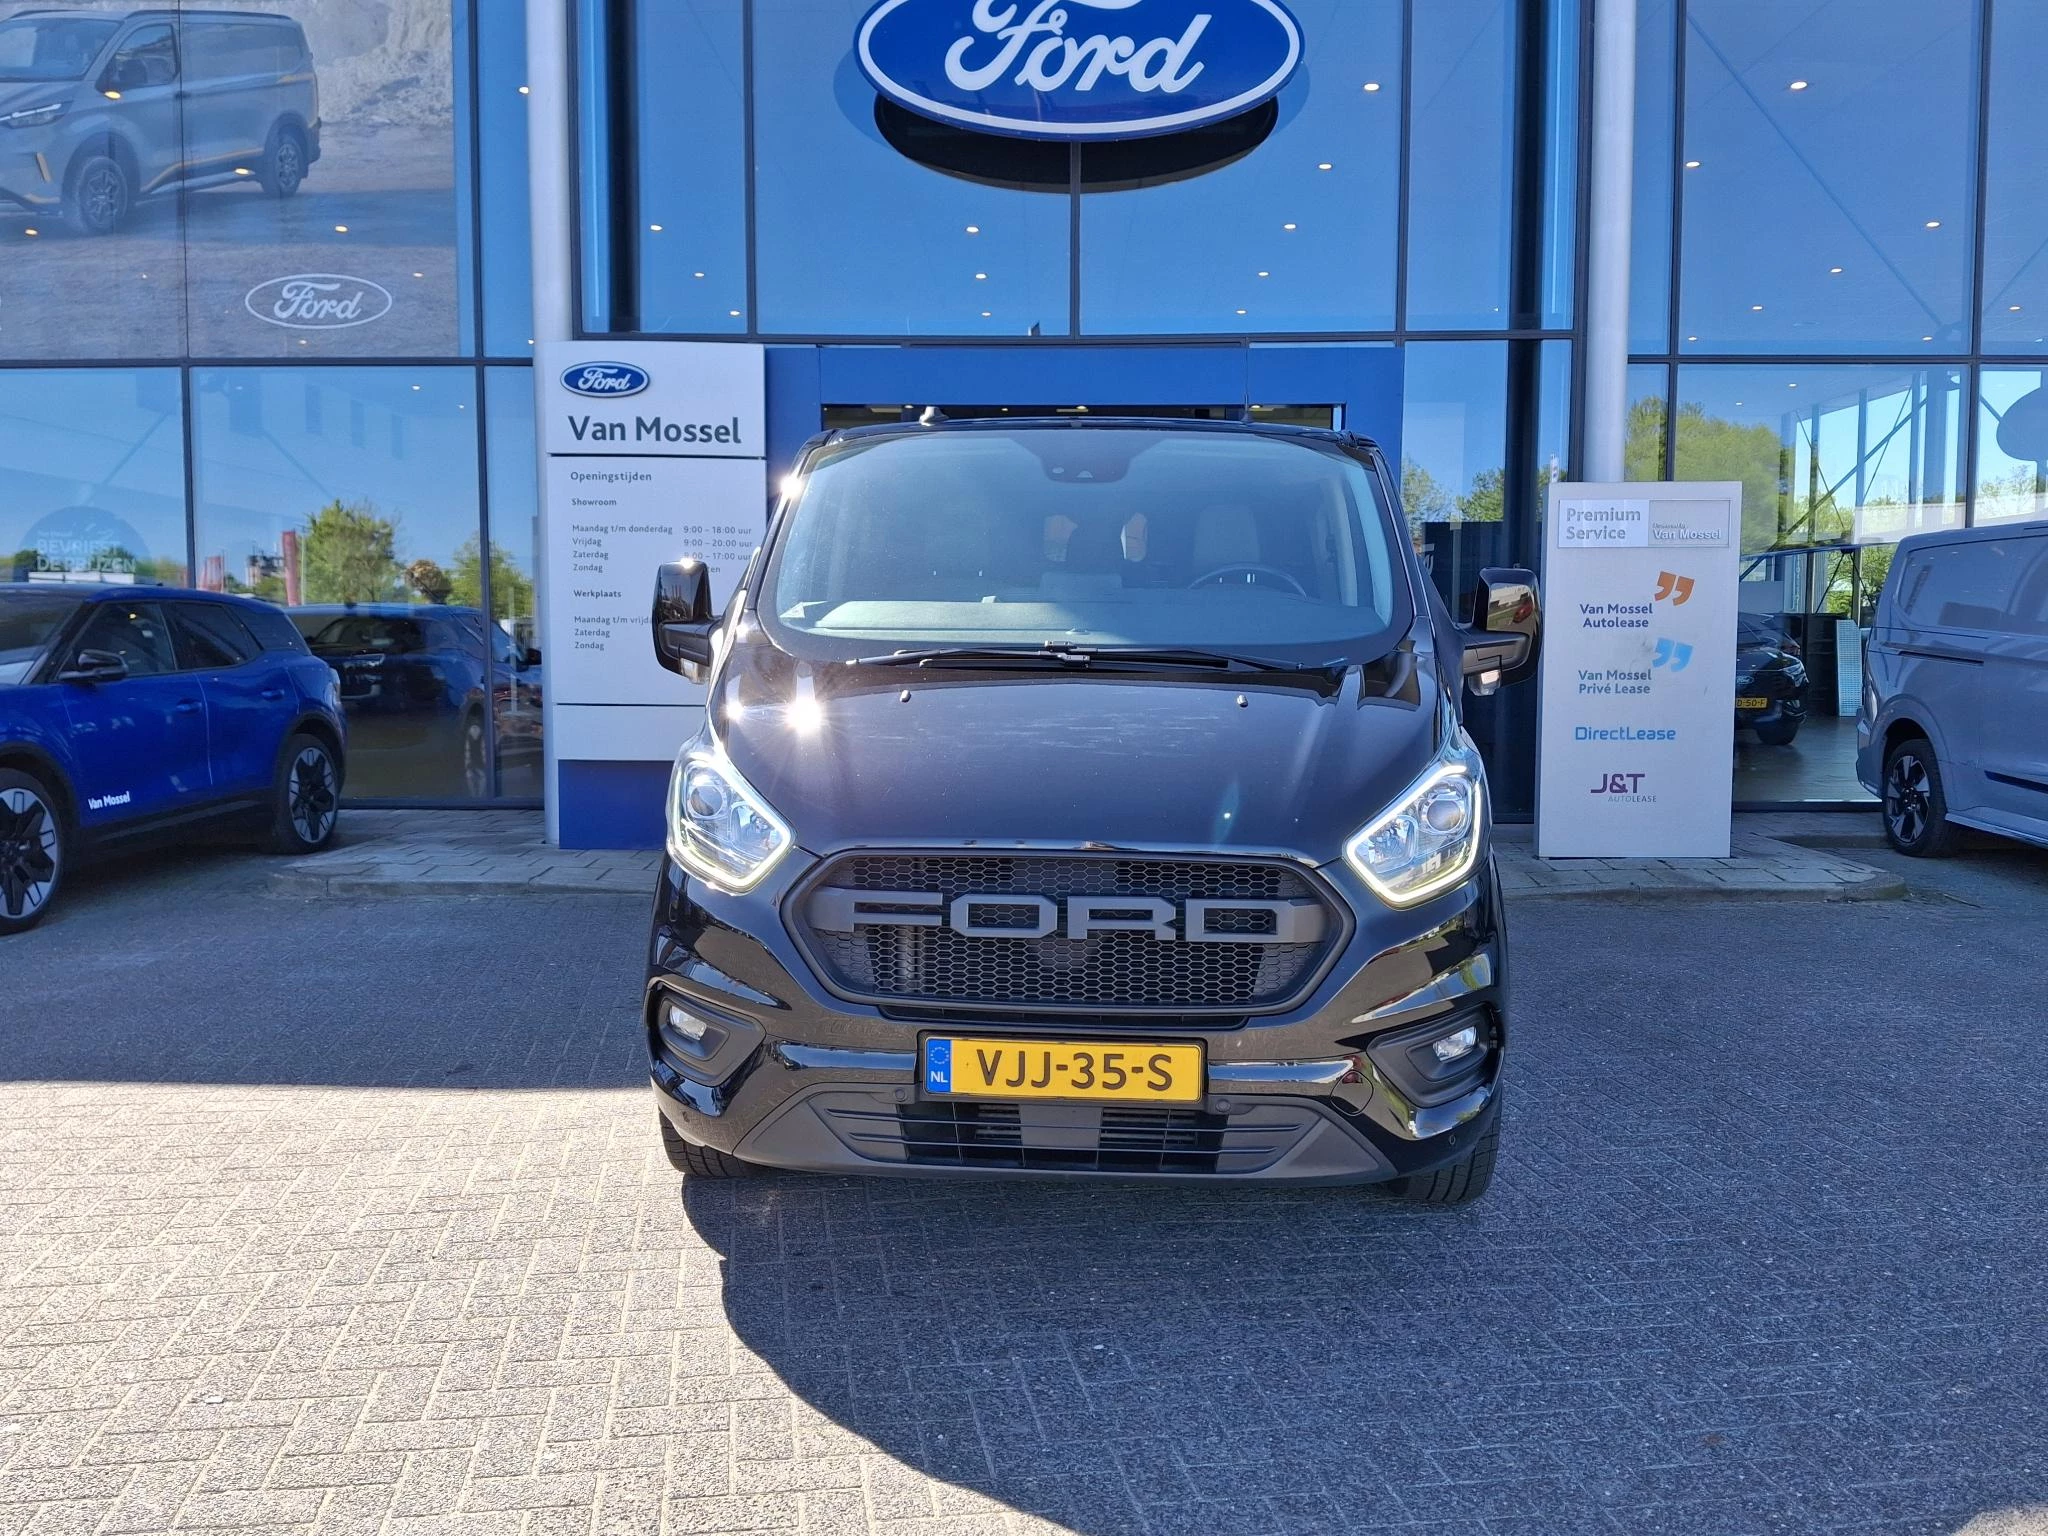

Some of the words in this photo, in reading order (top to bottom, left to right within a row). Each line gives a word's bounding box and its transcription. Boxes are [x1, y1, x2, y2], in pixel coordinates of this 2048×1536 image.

[943, 0, 1213, 93] Ford
[273, 281, 365, 319] Ford
[577, 366, 632, 391] Ford
[567, 415, 627, 441] Van
[635, 416, 743, 444] Mossel
[570, 471, 652, 484] Openingstijden
[571, 498, 617, 506] Showroom
[1566, 507, 1641, 521] Premium
[572, 524, 609, 535] Maandag
[611, 525, 626, 533] t/m
[628, 525, 673, 535] donderdag
[683, 526, 703, 534] 9:00
[712, 526, 736, 534] 18:00
[1566, 525, 1626, 540] Service
[1652, 529, 1676, 540] Van
[1679, 528, 1721, 540] Mossel
[572, 537, 602, 547] Vrijdag
[573, 550, 609, 561] Zaterdag
[712, 552, 736, 560] 17:00
[573, 563, 603, 573] Zondag
[574, 590, 622, 599] Werkplaats
[1580, 603, 1604, 614] Van
[1607, 602, 1654, 614] Mossel
[574, 616, 611, 625] Maandag
[613, 616, 628, 624] t/m
[631, 616, 652, 625] vrijd
[1583, 617, 1649, 628] Autolease
[575, 628, 611, 638] Zaterdag
[574, 641, 605, 651] Zondag
[1578, 670, 1603, 681] Van
[1606, 668, 1652, 681] Mossel
[1578, 683, 1611, 694] Privé
[1614, 683, 1651, 694] Lease
[1575, 726, 1677, 741] DirectLease
[1590, 773, 1646, 794] J&T
[88, 797, 103, 810] Van
[103, 790, 131, 807] Mossel
[1608, 795, 1657, 803] AUTOLEASE
[808, 885, 1327, 944] FORD
[976, 1048, 1173, 1092] VJJ-35-S
[930, 1070, 949, 1084] NL
